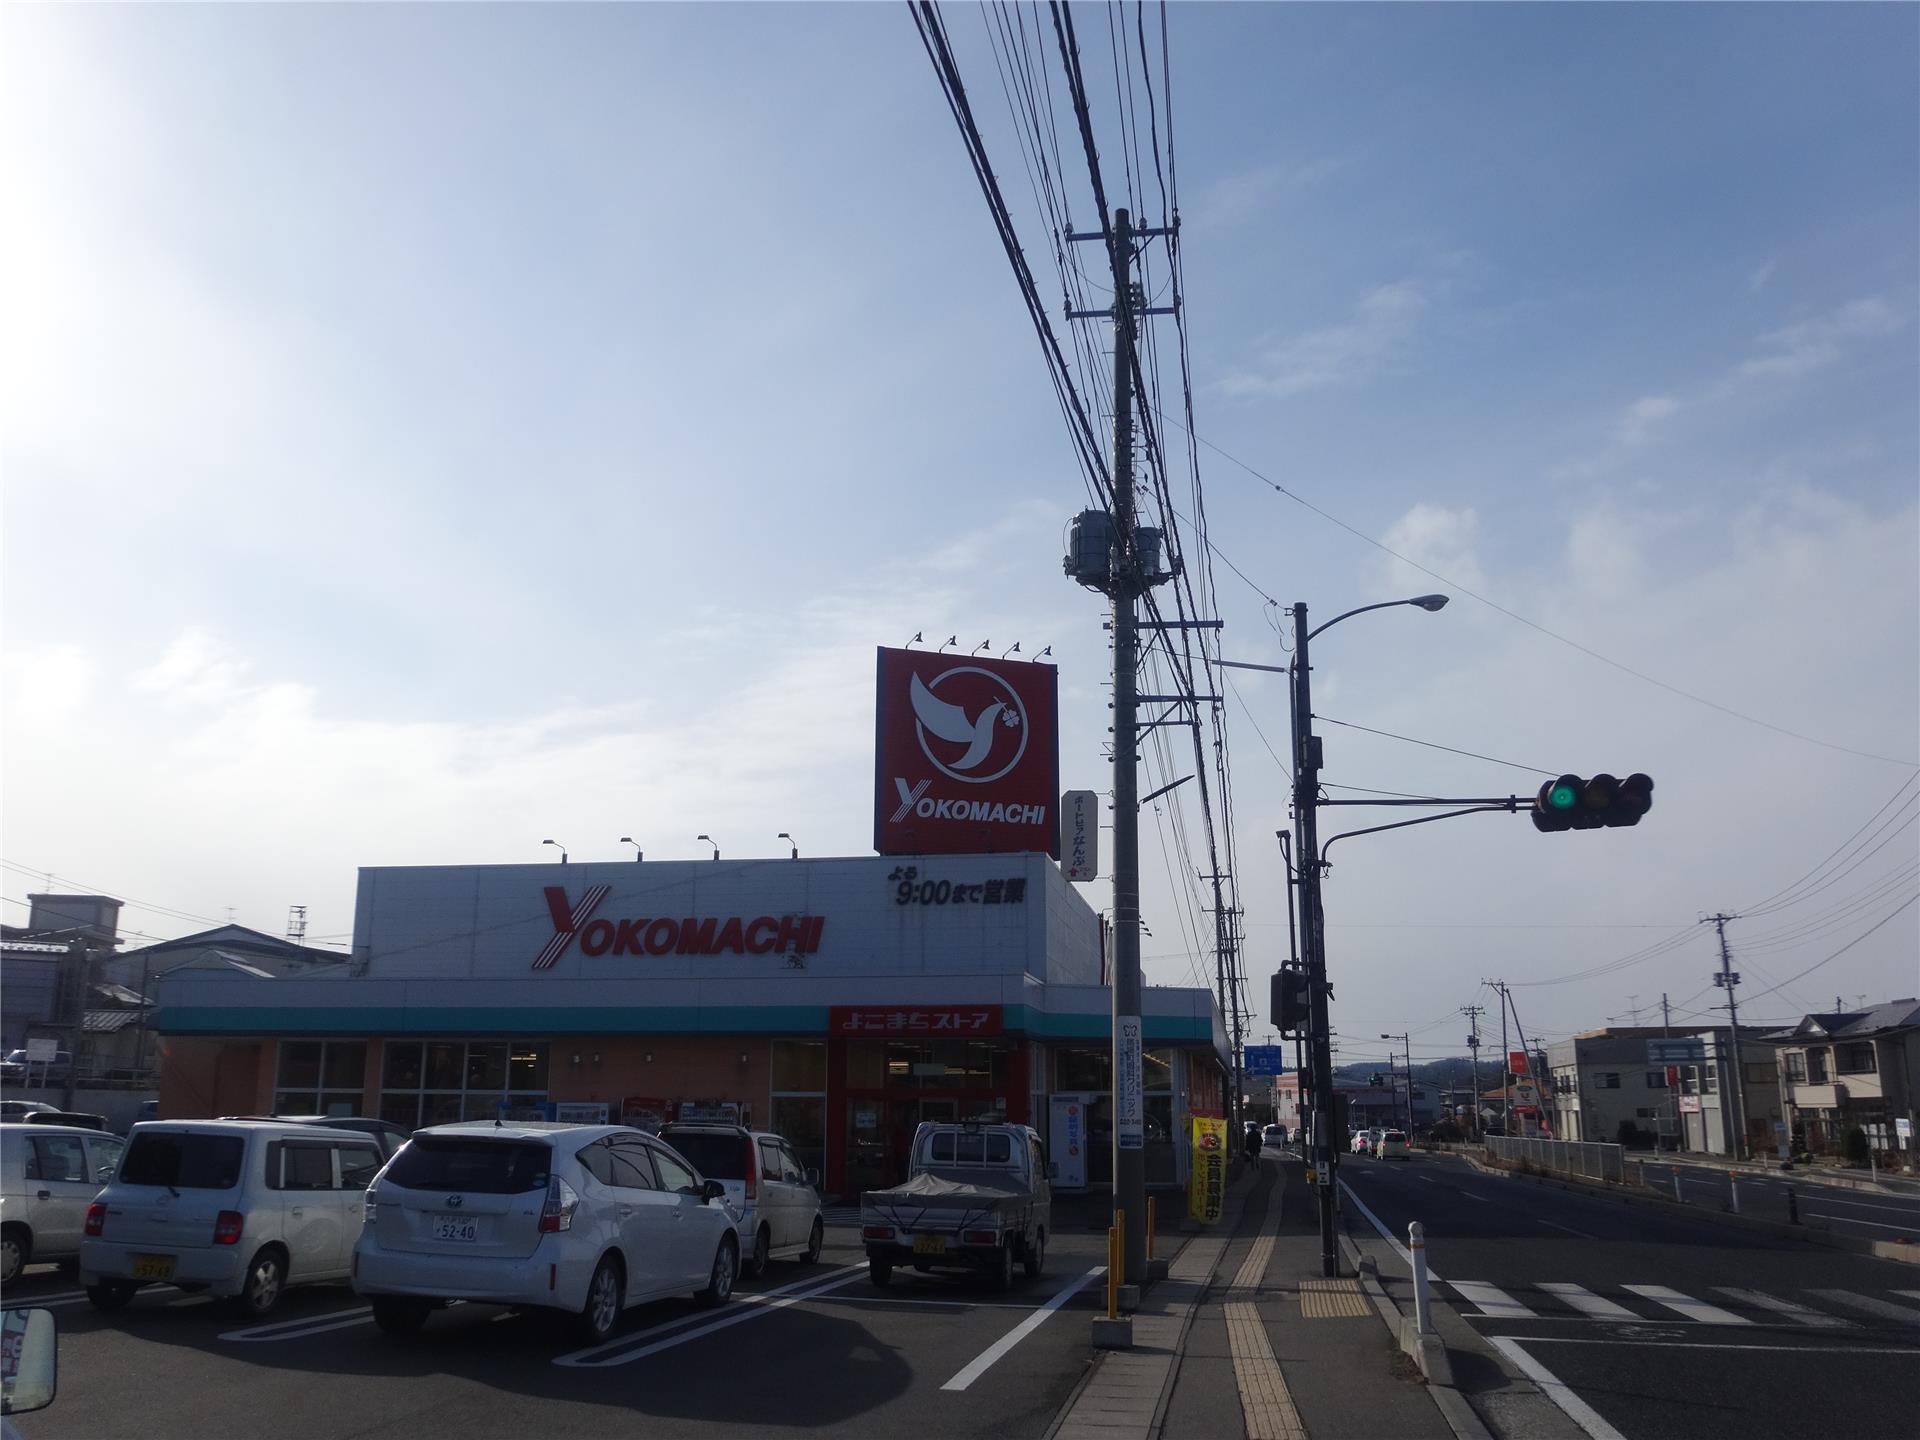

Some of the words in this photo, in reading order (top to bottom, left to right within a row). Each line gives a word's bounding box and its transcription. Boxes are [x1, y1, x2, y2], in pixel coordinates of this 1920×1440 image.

[889, 777, 1046, 825] YOKOMACHI
[887, 865, 918, 881] よる
[896, 877, 1027, 906] 9:00まで営業
[531, 885, 826, 970] YOKOMACHI
[842, 1012, 990, 1030] よこまちストア
